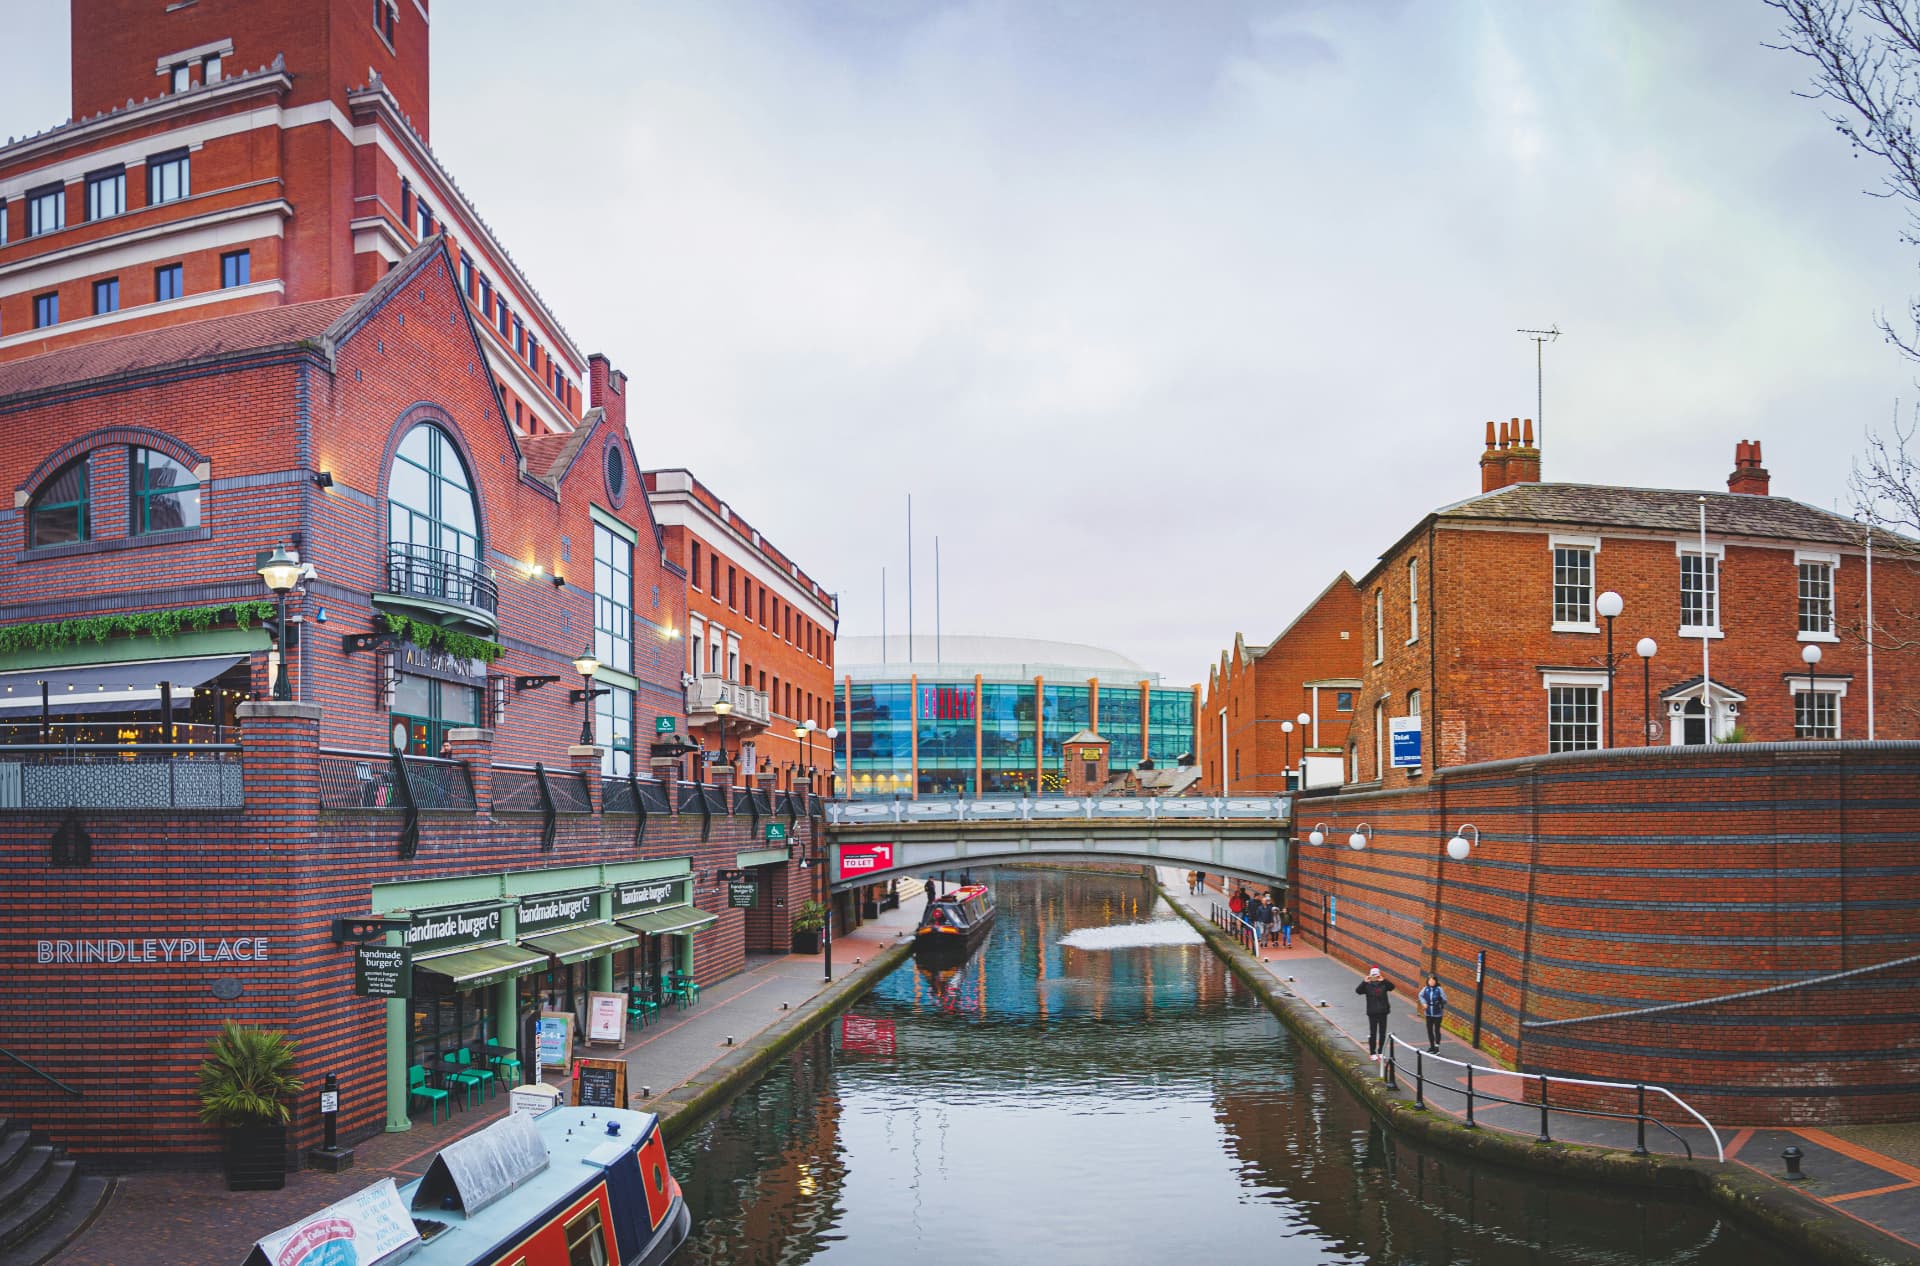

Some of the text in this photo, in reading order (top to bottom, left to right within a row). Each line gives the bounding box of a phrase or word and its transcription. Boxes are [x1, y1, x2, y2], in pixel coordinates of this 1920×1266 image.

[406, 648, 426, 667] ALL
[621, 887, 649, 905] handmade
[649, 886, 666, 904] burger
[519, 901, 559, 924] handmade
[558, 900, 582, 920] burger
[458, 914, 489, 938] burger
[37, 937, 269, 964] BRINDLEYPLACE
[360, 949, 402, 960] handmade
[366, 958, 393, 969] burger
